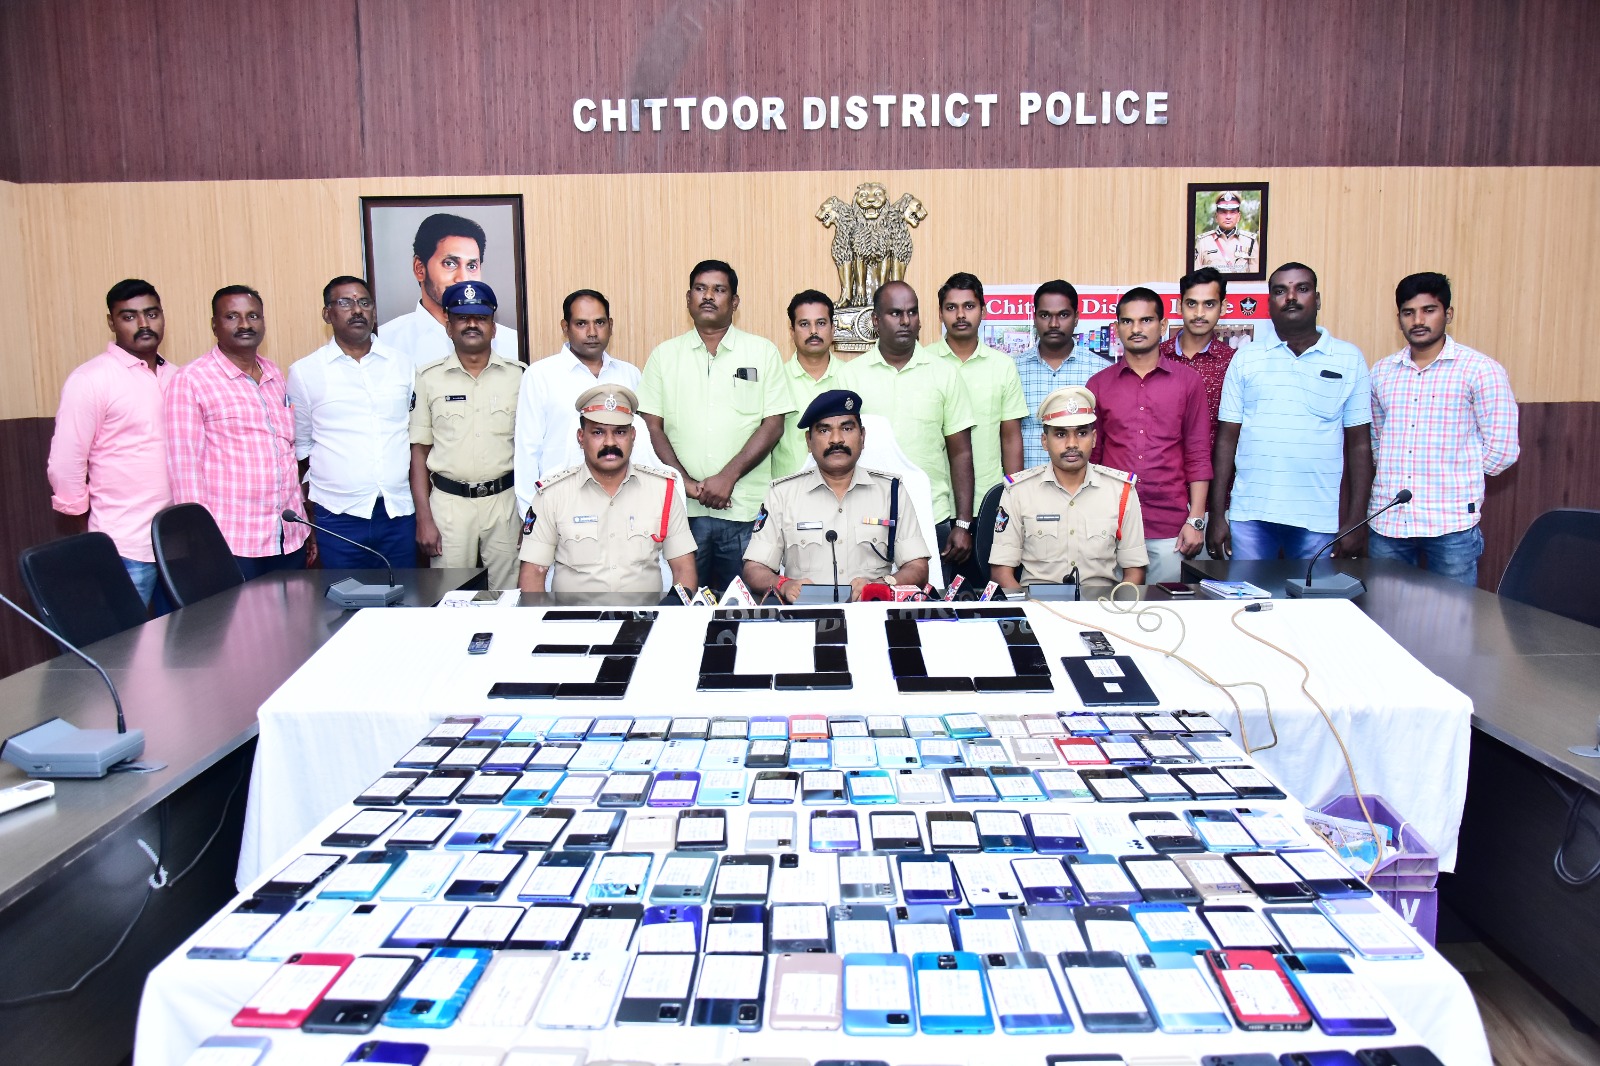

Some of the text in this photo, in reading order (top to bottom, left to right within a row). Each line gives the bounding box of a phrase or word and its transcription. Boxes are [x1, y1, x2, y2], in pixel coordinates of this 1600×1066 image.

[573, 89, 1169, 133] CHITTOOR DISTRICT POLICE
